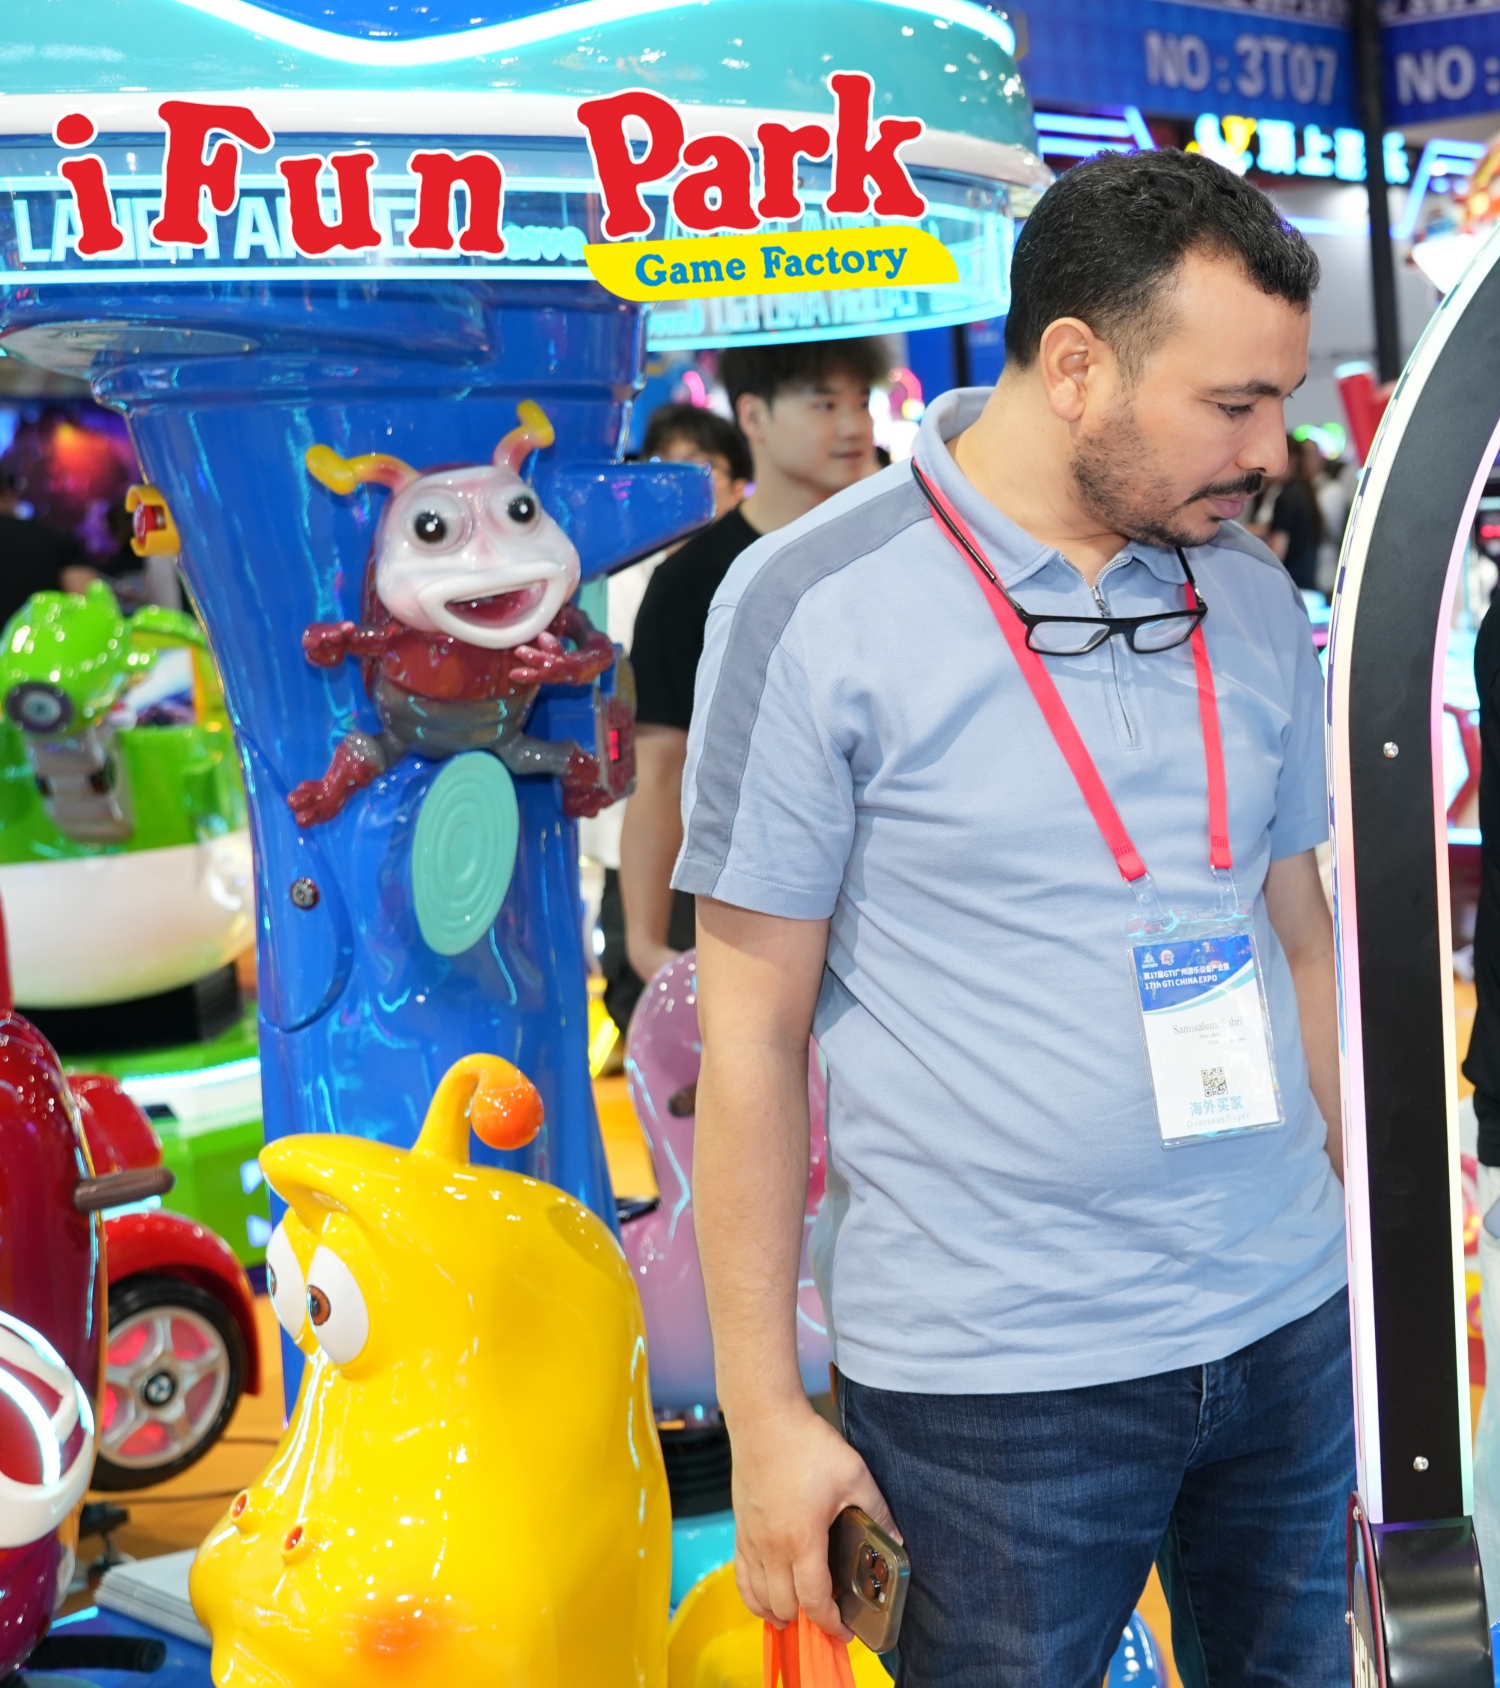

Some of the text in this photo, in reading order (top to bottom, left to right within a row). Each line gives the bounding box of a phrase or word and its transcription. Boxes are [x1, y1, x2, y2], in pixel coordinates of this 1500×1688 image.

[1145, 975, 1217, 990] 17th GTI CHINA EXPO
[1190, 1096, 1243, 1116] 海外买家
[1187, 1116, 1226, 1128] Overseas
